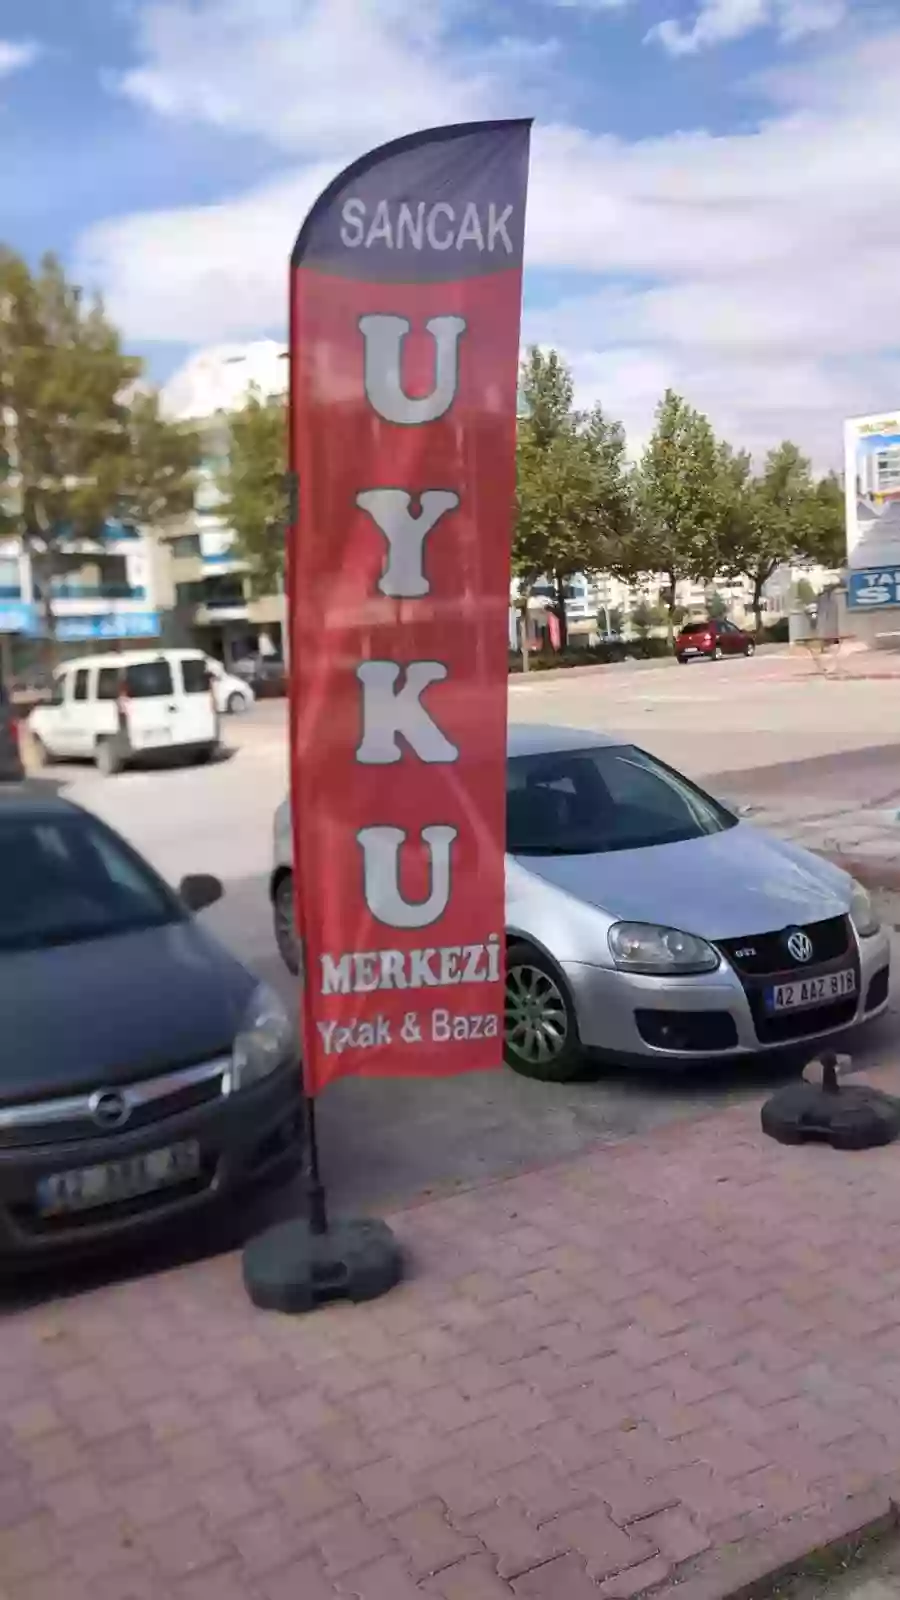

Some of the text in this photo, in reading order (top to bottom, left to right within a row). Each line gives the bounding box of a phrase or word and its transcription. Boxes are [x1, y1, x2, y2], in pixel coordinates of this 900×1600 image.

[340, 197, 514, 254] SANCAK
[320, 932, 501, 995] MERKEZİ
[776, 987, 794, 1006] 42
[400, 1011, 422, 1043] &
[431, 1008, 499, 1042] Baza
